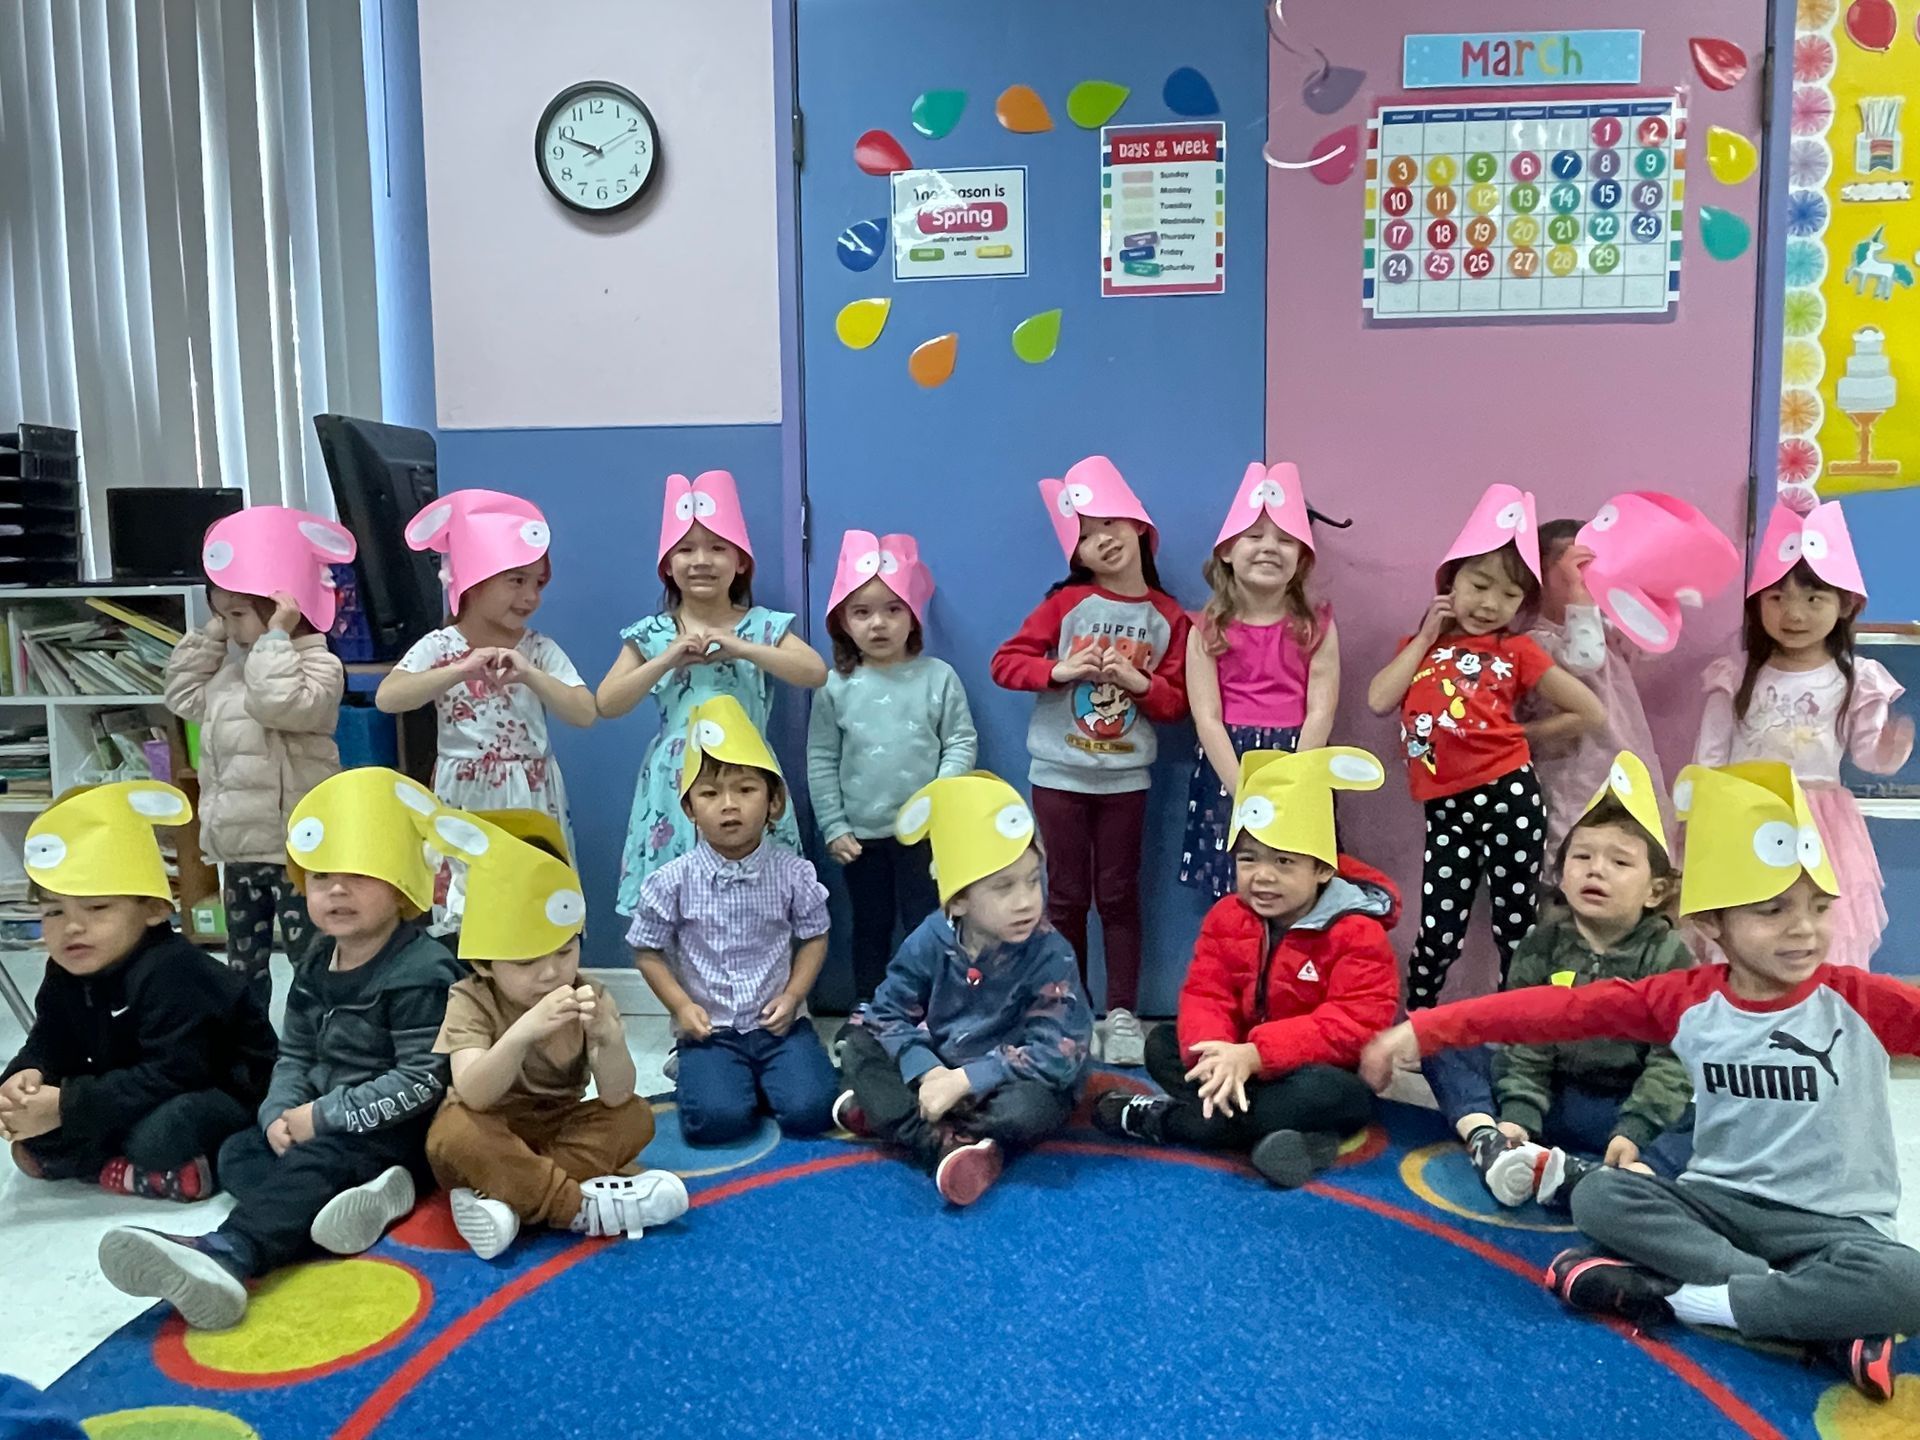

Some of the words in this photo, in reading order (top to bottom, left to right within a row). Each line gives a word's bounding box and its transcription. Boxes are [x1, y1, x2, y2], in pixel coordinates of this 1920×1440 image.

[1461, 36, 1583, 77] March
[572, 106, 583, 121] 11
[589, 99, 604, 114] 12
[616, 104, 620, 119] 1
[627, 118, 638, 132] 2
[1603, 123, 1611, 141] 1
[1649, 122, 1660, 141] 2
[558, 125, 575, 141] 10
[552, 146, 564, 160] 9
[635, 140, 646, 155] 3
[561, 167, 573, 181] 8
[629, 163, 641, 177] 4
[1398, 162, 1408, 180] 3
[1436, 160, 1447, 178] 4
[1476, 158, 1488, 176] 5
[1520, 157, 1532, 175] 6
[1562, 155, 1574, 174] 7
[1601, 154, 1611, 173] 8
[1645, 153, 1657, 172] 9
[1160, 171, 1190, 179] Sunday
[577, 182, 588, 196] 7
[596, 186, 608, 200] 6
[616, 179, 628, 194] 5
[995, 184, 1006, 197] is
[1160, 186, 1192, 194] Monday
[1390, 192, 1407, 211] 10
[1435, 192, 1448, 211] 11
[1476, 189, 1492, 206] 12
[1518, 189, 1533, 207] 13
[1557, 187, 1574, 207] 14
[1600, 184, 1615, 203] 15
[1640, 185, 1658, 205] 16
[1160, 202, 1193, 210] Tuesday
[932, 208, 993, 230] Spring
[1160, 233, 1196, 241] Thursday
[1392, 225, 1407, 244] 17
[1435, 224, 1451, 243] 18
[1474, 223, 1490, 241] 19
[1512, 222, 1535, 242] 20
[1555, 220, 1573, 239] 21
[1595, 217, 1614, 235] 22
[1637, 216, 1656, 235] 23
[1160, 249, 1184, 257] Friday
[1160, 264, 1195, 272] Saturday
[1388, 259, 1407, 277] 24
[1429, 255, 1450, 274] 25
[1469, 253, 1489, 273] 26
[1514, 252, 1535, 271] 27
[1553, 251, 1572, 269] 28
[1595, 248, 1615, 267] 29
[1092, 623, 1147, 640] SUPER
[1702, 1062, 1819, 1102] PUMA
